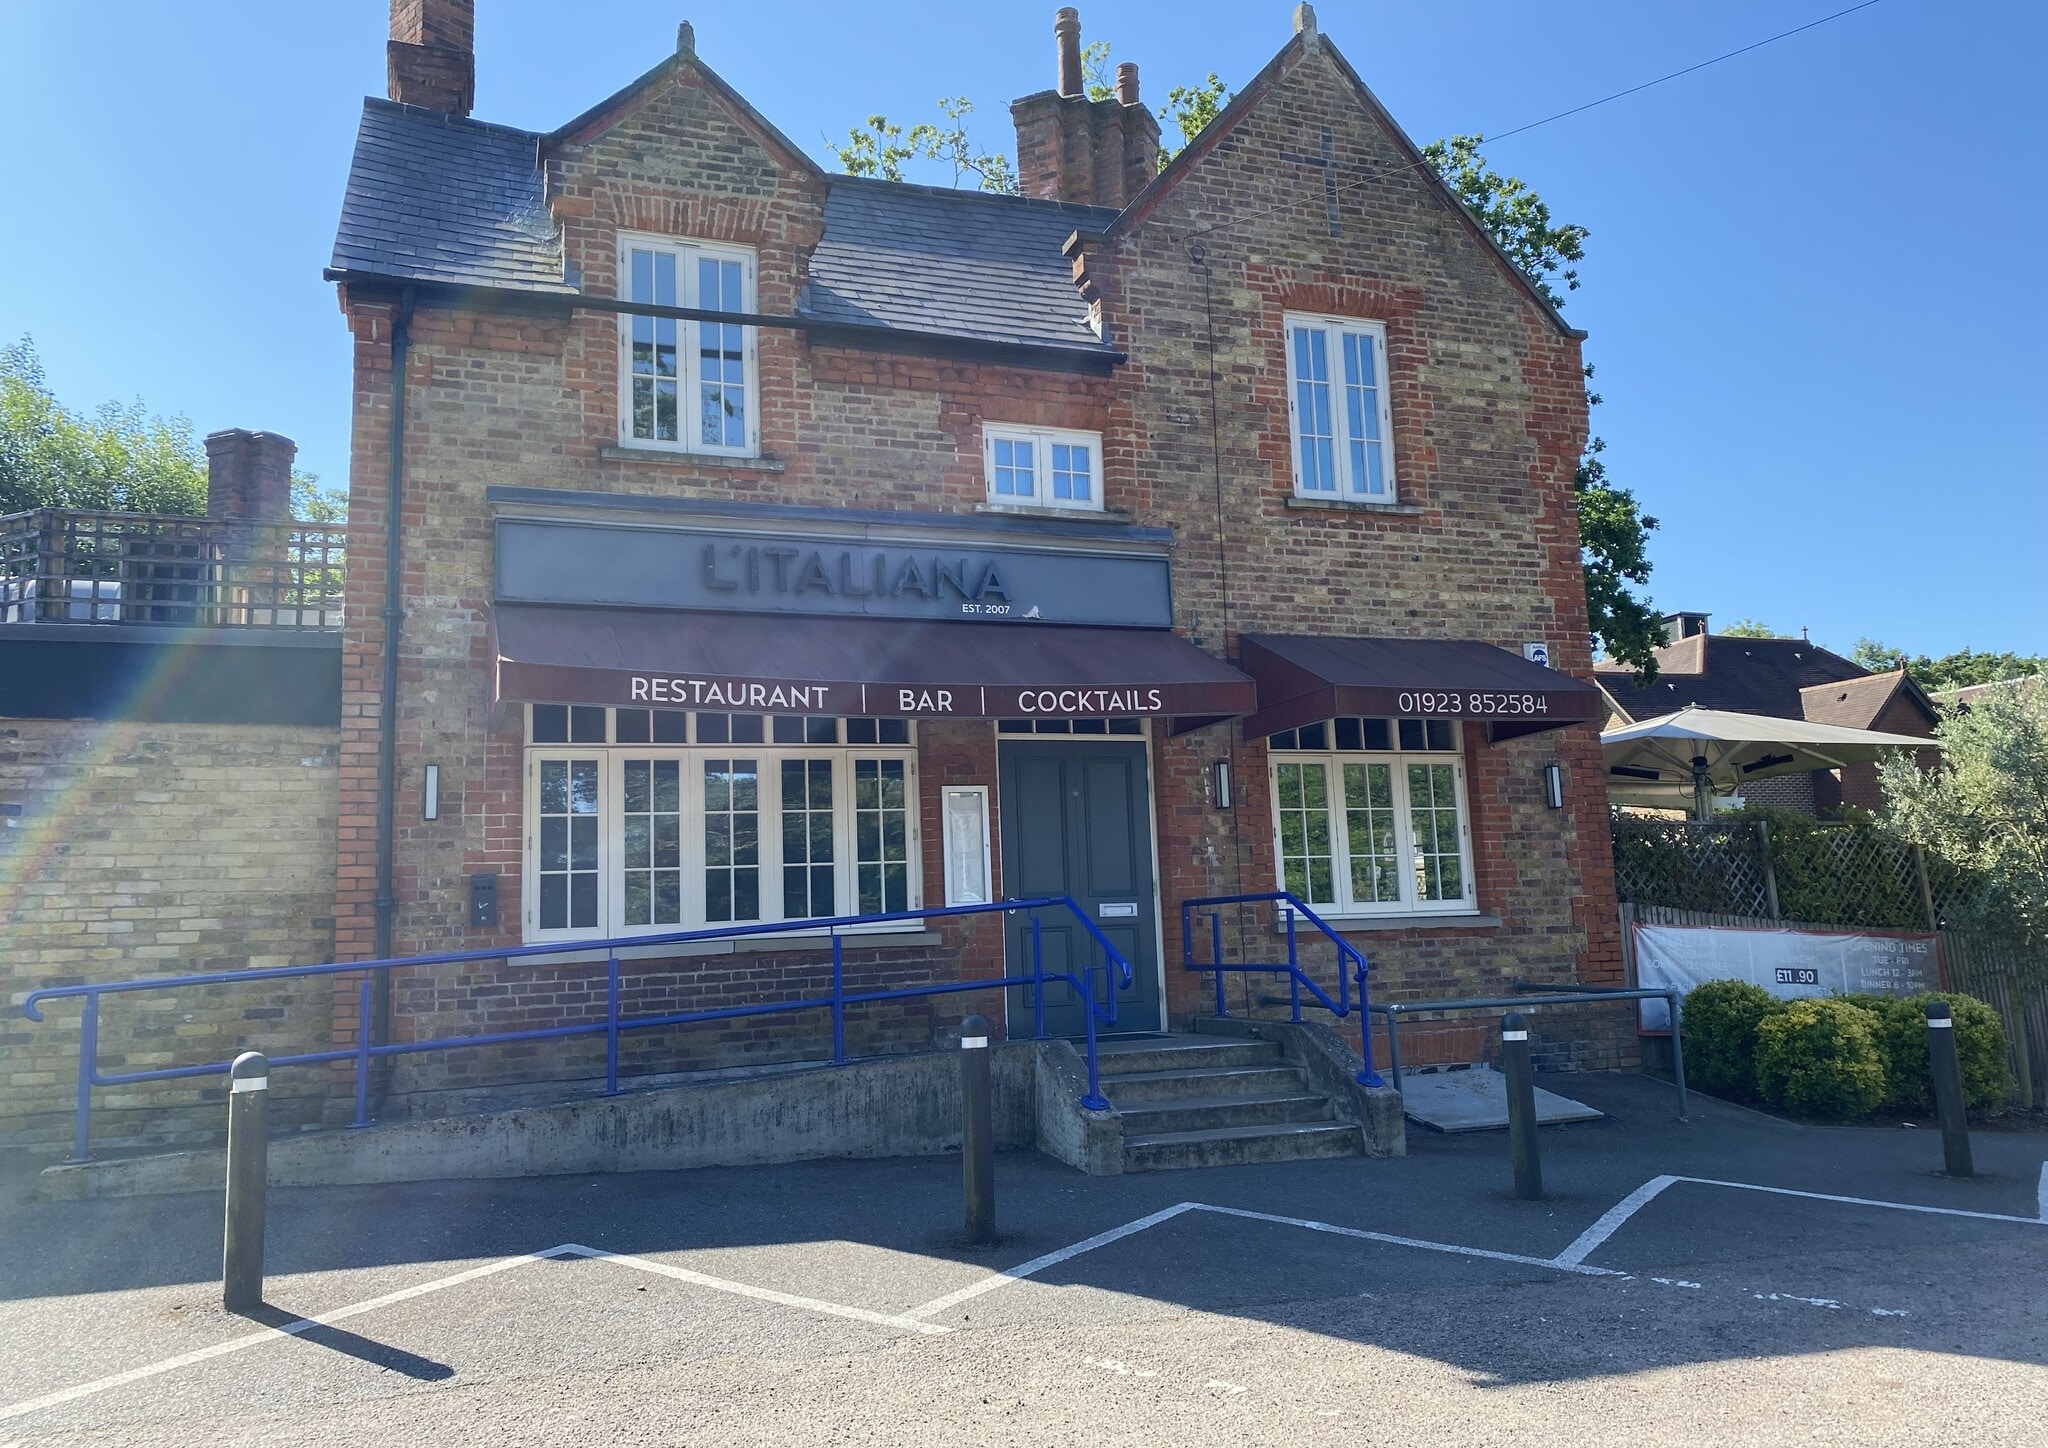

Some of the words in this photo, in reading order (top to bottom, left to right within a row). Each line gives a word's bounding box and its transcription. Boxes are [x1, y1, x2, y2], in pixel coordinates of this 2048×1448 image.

[703, 543, 1012, 601] L'ITALIANA
[962, 603, 983, 614] EST.
[985, 604, 1010, 615] 2007
[631, 677, 829, 709] RESTAURANT
[899, 689, 953, 712] BAR
[1018, 689, 1162, 712] COCKTAILS
[1399, 692, 1462, 713] 01923
[1469, 693, 1548, 714] 852584
[1850, 942, 1896, 953] OPENING
[1900, 942, 1928, 953] TIMES
[1872, 956, 1888, 965] TUE
[1896, 956, 1909, 965] FRI
[1861, 968, 1890, 977] LUNCH
[1860, 980, 1892, 989] DINNER
